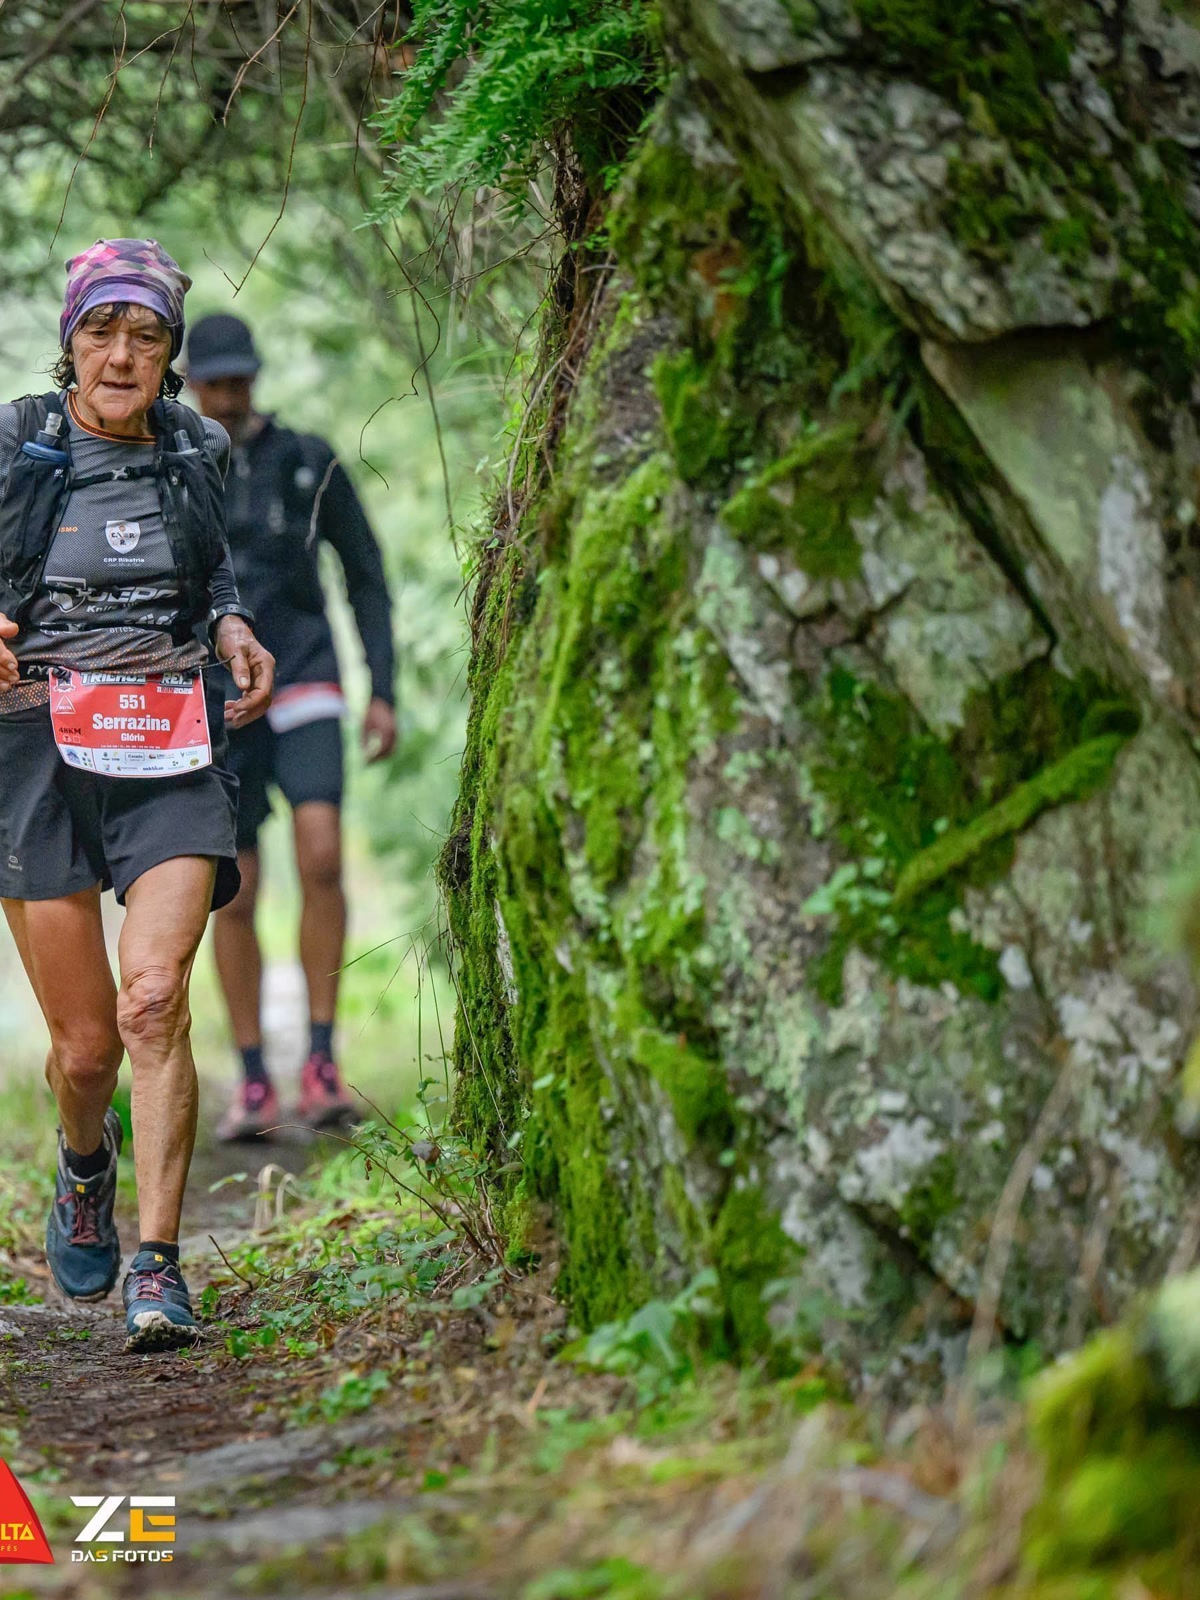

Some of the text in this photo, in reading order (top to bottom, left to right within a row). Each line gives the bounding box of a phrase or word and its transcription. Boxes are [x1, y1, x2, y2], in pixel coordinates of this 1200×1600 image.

[119, 694, 146, 710] 551
[92, 713, 170, 732] Serrazina
[58, 726, 82, 735] 48KM
[120, 732, 146, 742] Glória
